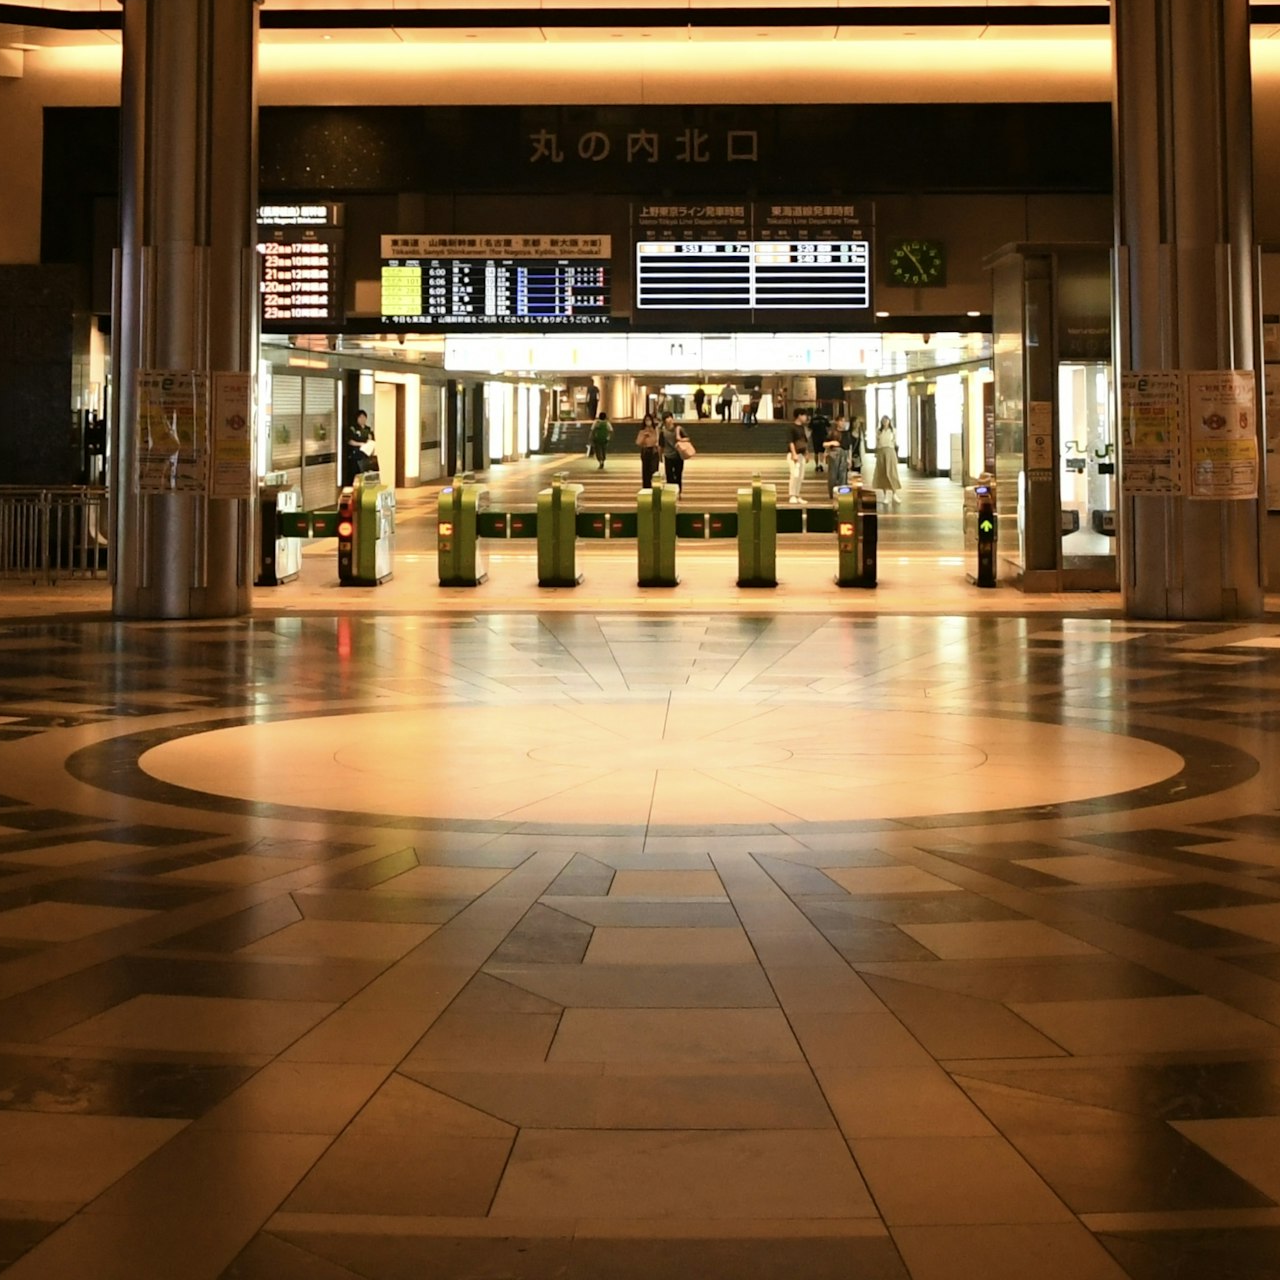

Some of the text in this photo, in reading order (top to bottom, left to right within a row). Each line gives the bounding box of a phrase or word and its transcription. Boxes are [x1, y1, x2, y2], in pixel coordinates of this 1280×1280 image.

[528, 127, 758, 163] 丸の内北口
[446, 247, 485, 256] Shinkansen
[439, 522, 453, 536] IC
[840, 522, 854, 536] IC
